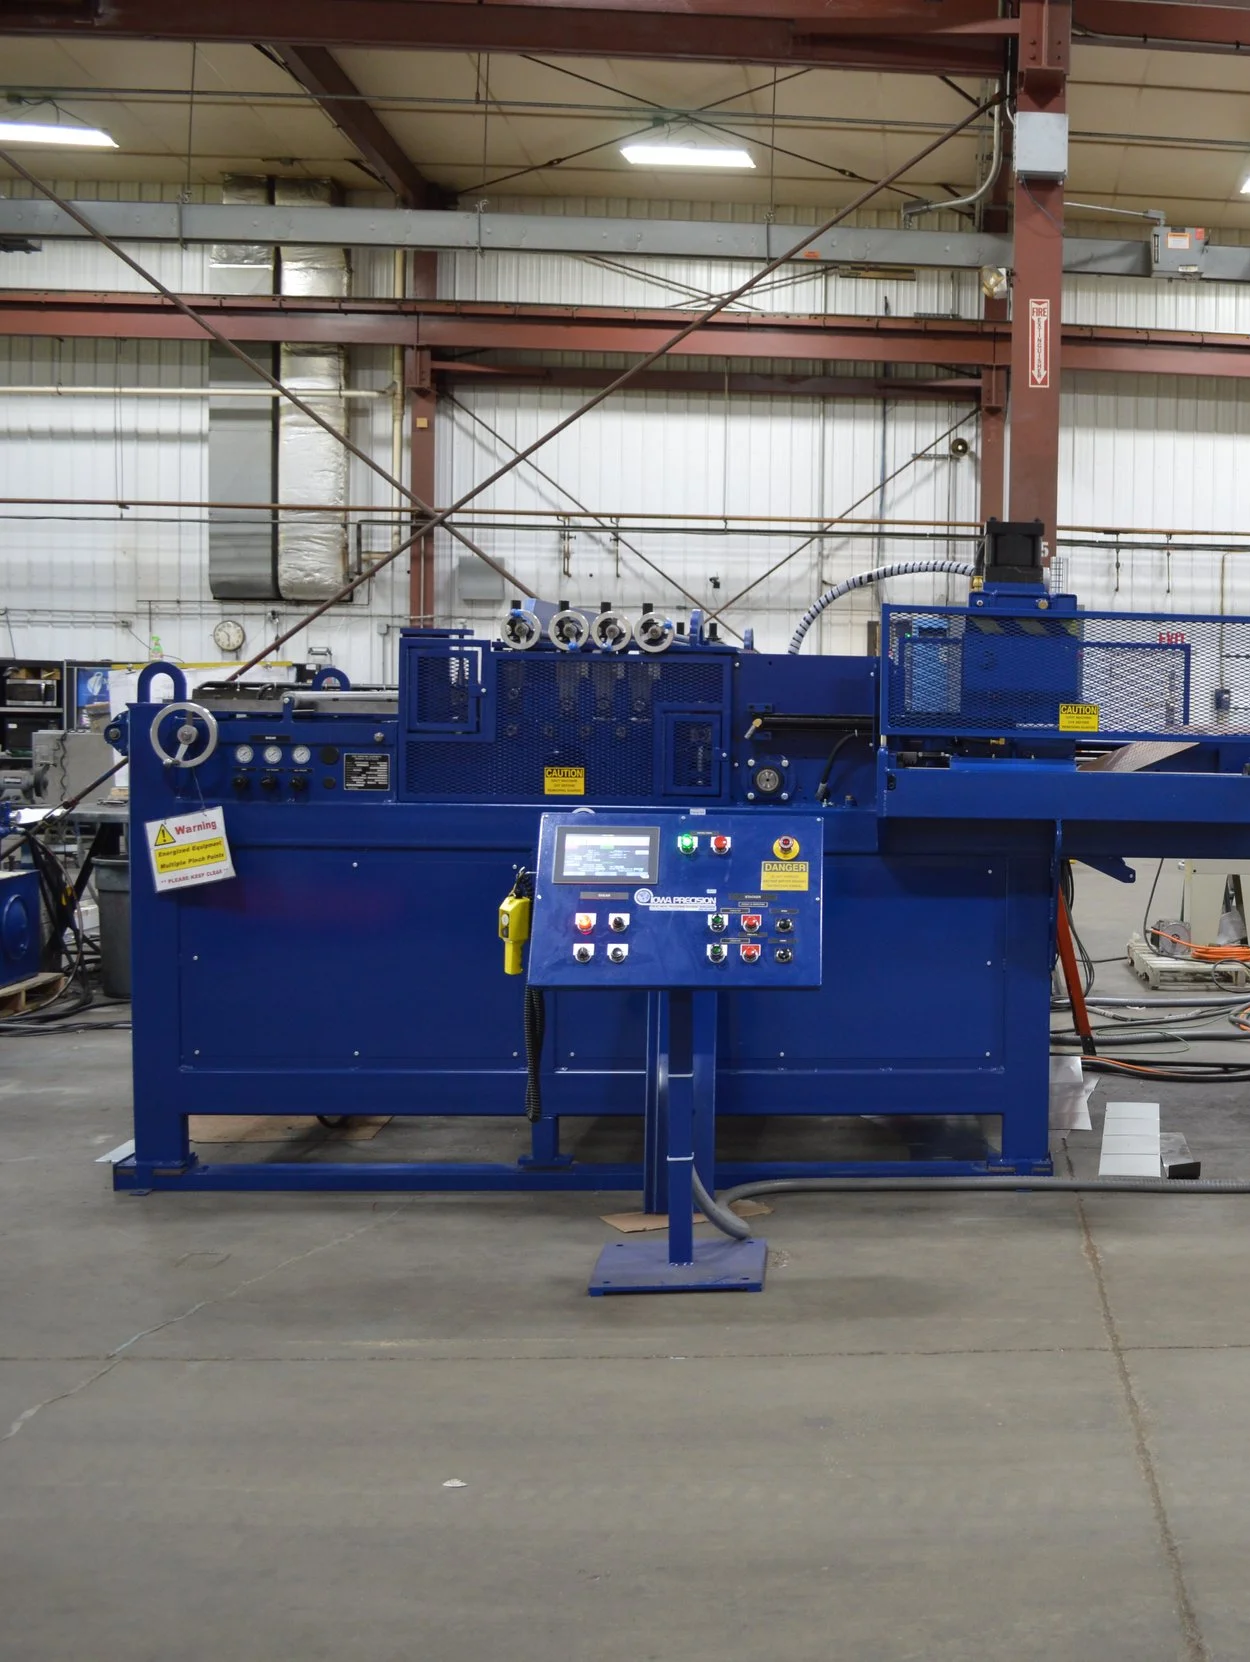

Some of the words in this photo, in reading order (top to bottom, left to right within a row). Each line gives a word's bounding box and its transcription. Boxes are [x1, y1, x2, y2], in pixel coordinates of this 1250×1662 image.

[1032, 307, 1047, 317] FIRE
[1061, 705, 1097, 714] CAUTION
[546, 769, 583, 777] CAUTION
[174, 821, 217, 835] Warning
[765, 863, 806, 872] DANGER
[650, 896, 672, 904] IOWA
[672, 896, 717, 904] PRECISION
